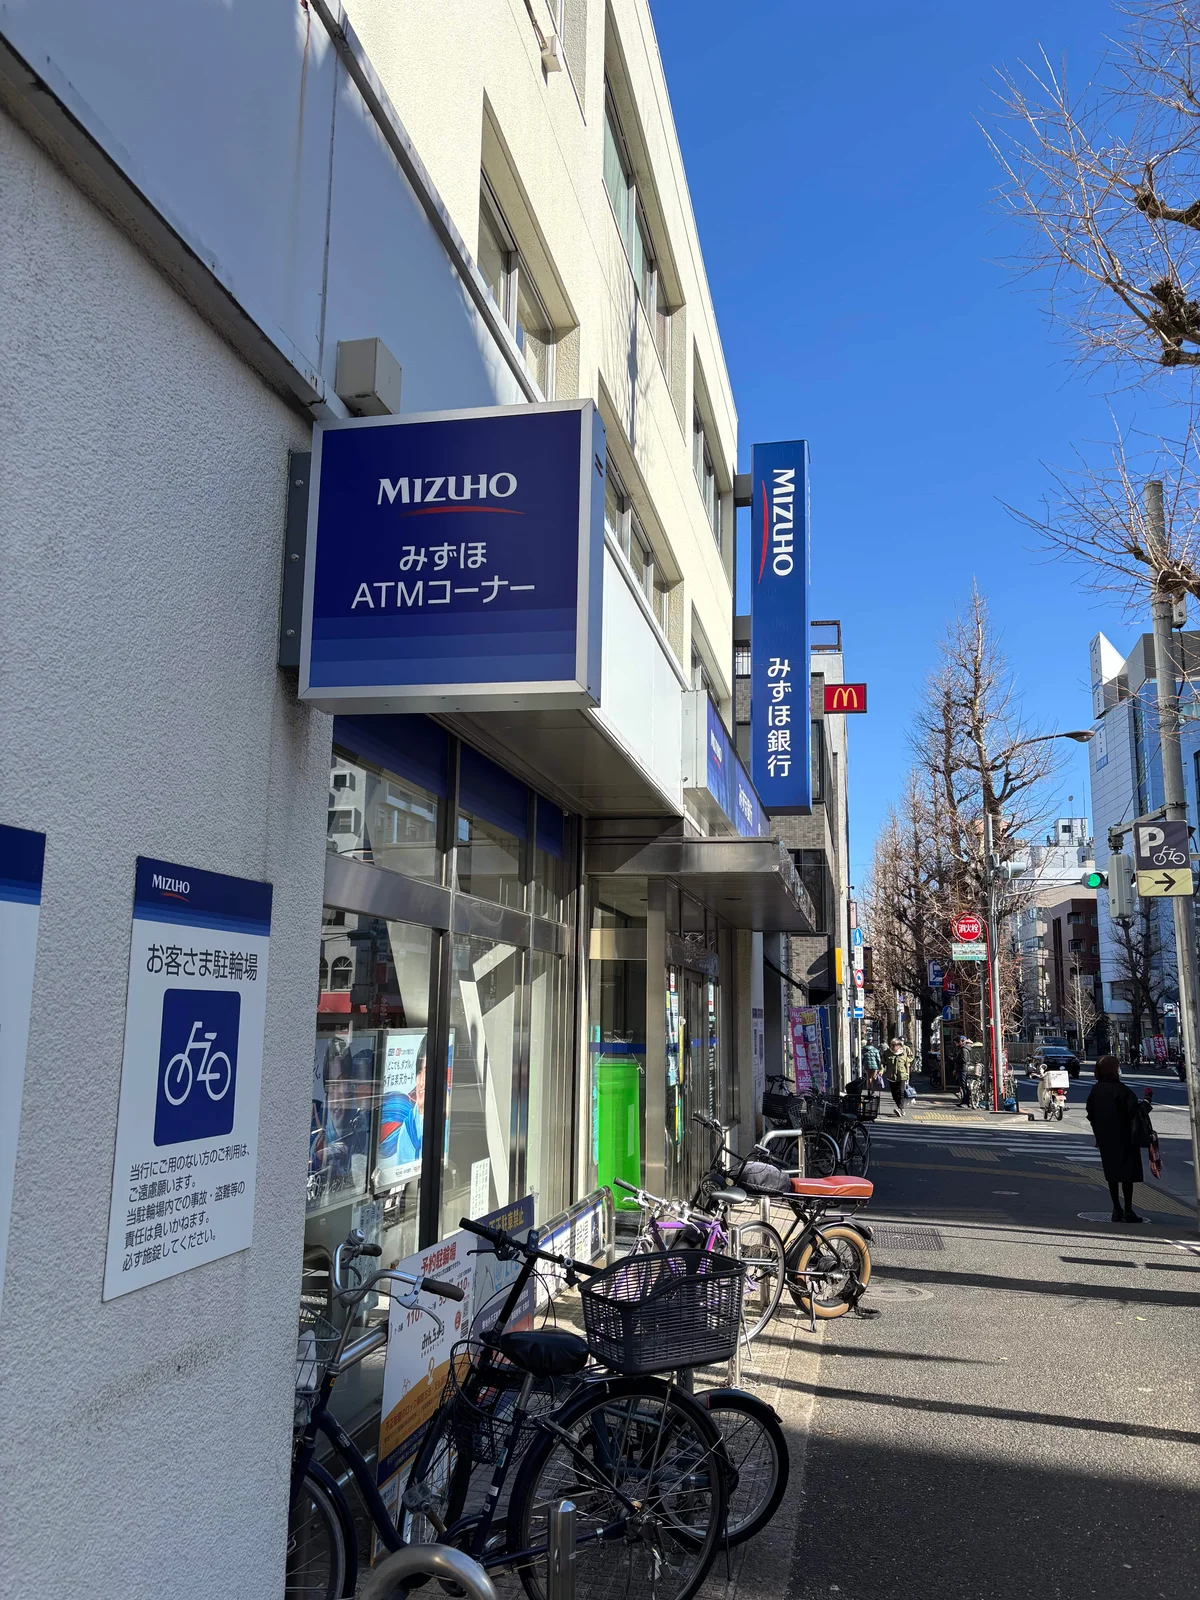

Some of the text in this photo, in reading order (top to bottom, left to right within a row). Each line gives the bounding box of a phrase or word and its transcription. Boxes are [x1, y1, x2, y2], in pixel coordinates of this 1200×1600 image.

[377, 472, 518, 505] MIZUHO
[773, 468, 795, 576] MIZUHO
[399, 542, 487, 571] みずほ
[351, 575, 535, 609] ATMコーナー
[767, 657, 792, 777] みずほ銀行
[1138, 826, 1165, 858] P
[152, 873, 190, 894] MIZUHO
[958, 923, 979, 933] 消火栓
[146, 943, 258, 981] お客さま駐輪場
[130, 1143, 250, 1182] 当行にご用のない方のご利用は、
[125, 1181, 246, 1227] 当駐輪場内での事故・盗難等の
[128, 1174, 196, 1203] ご遠慮願います。
[124, 1211, 210, 1249] 責任は負いかねます。
[122, 1229, 217, 1272] 必ず施錠してください。
